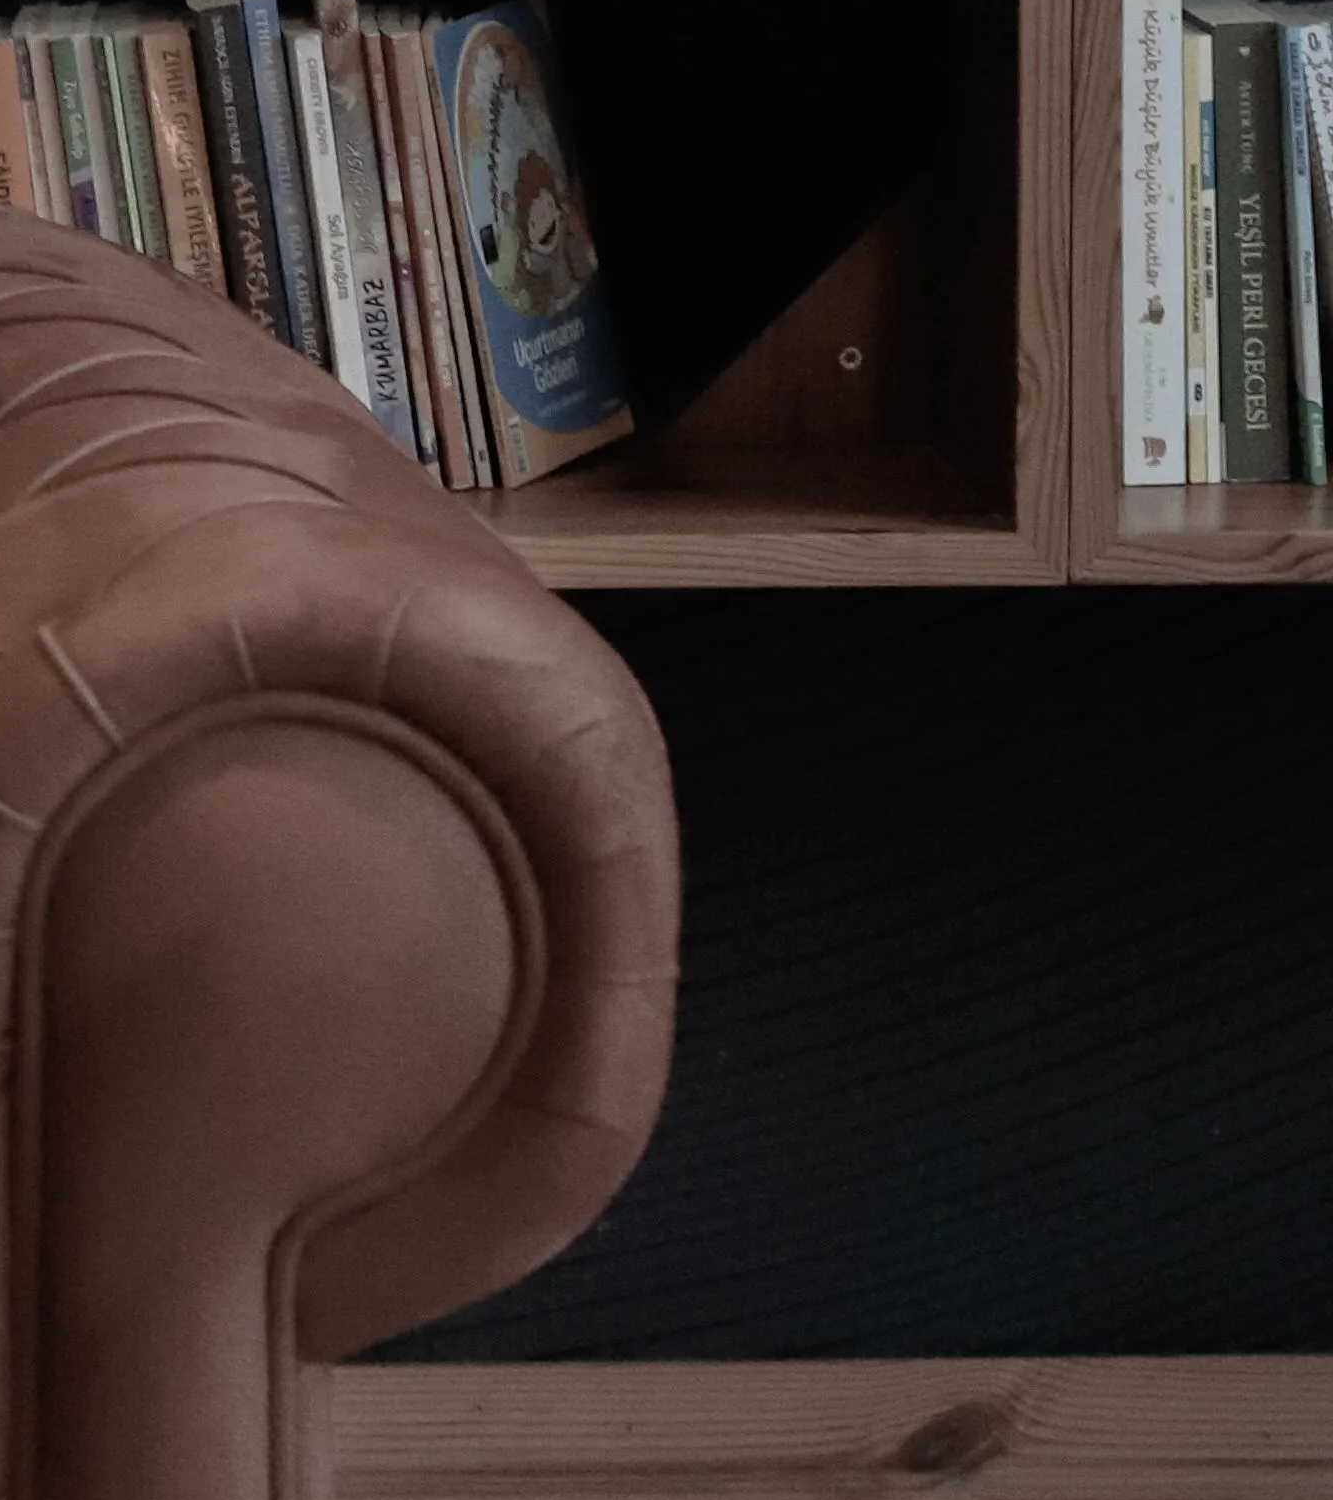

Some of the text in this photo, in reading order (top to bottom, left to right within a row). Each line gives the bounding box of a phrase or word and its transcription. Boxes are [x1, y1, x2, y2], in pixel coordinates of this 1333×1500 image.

[1135, 8, 1161, 74] Küçük
[1135, 143, 1161, 206] Büyük
[229, 172, 276, 335] ALPARSLA
[326, 212, 352, 301] Sol Ayağım
[361, 278, 401, 402] KUMARBAZ
[1232, 192, 1270, 430] YEŞİL PERİ GECESİ
